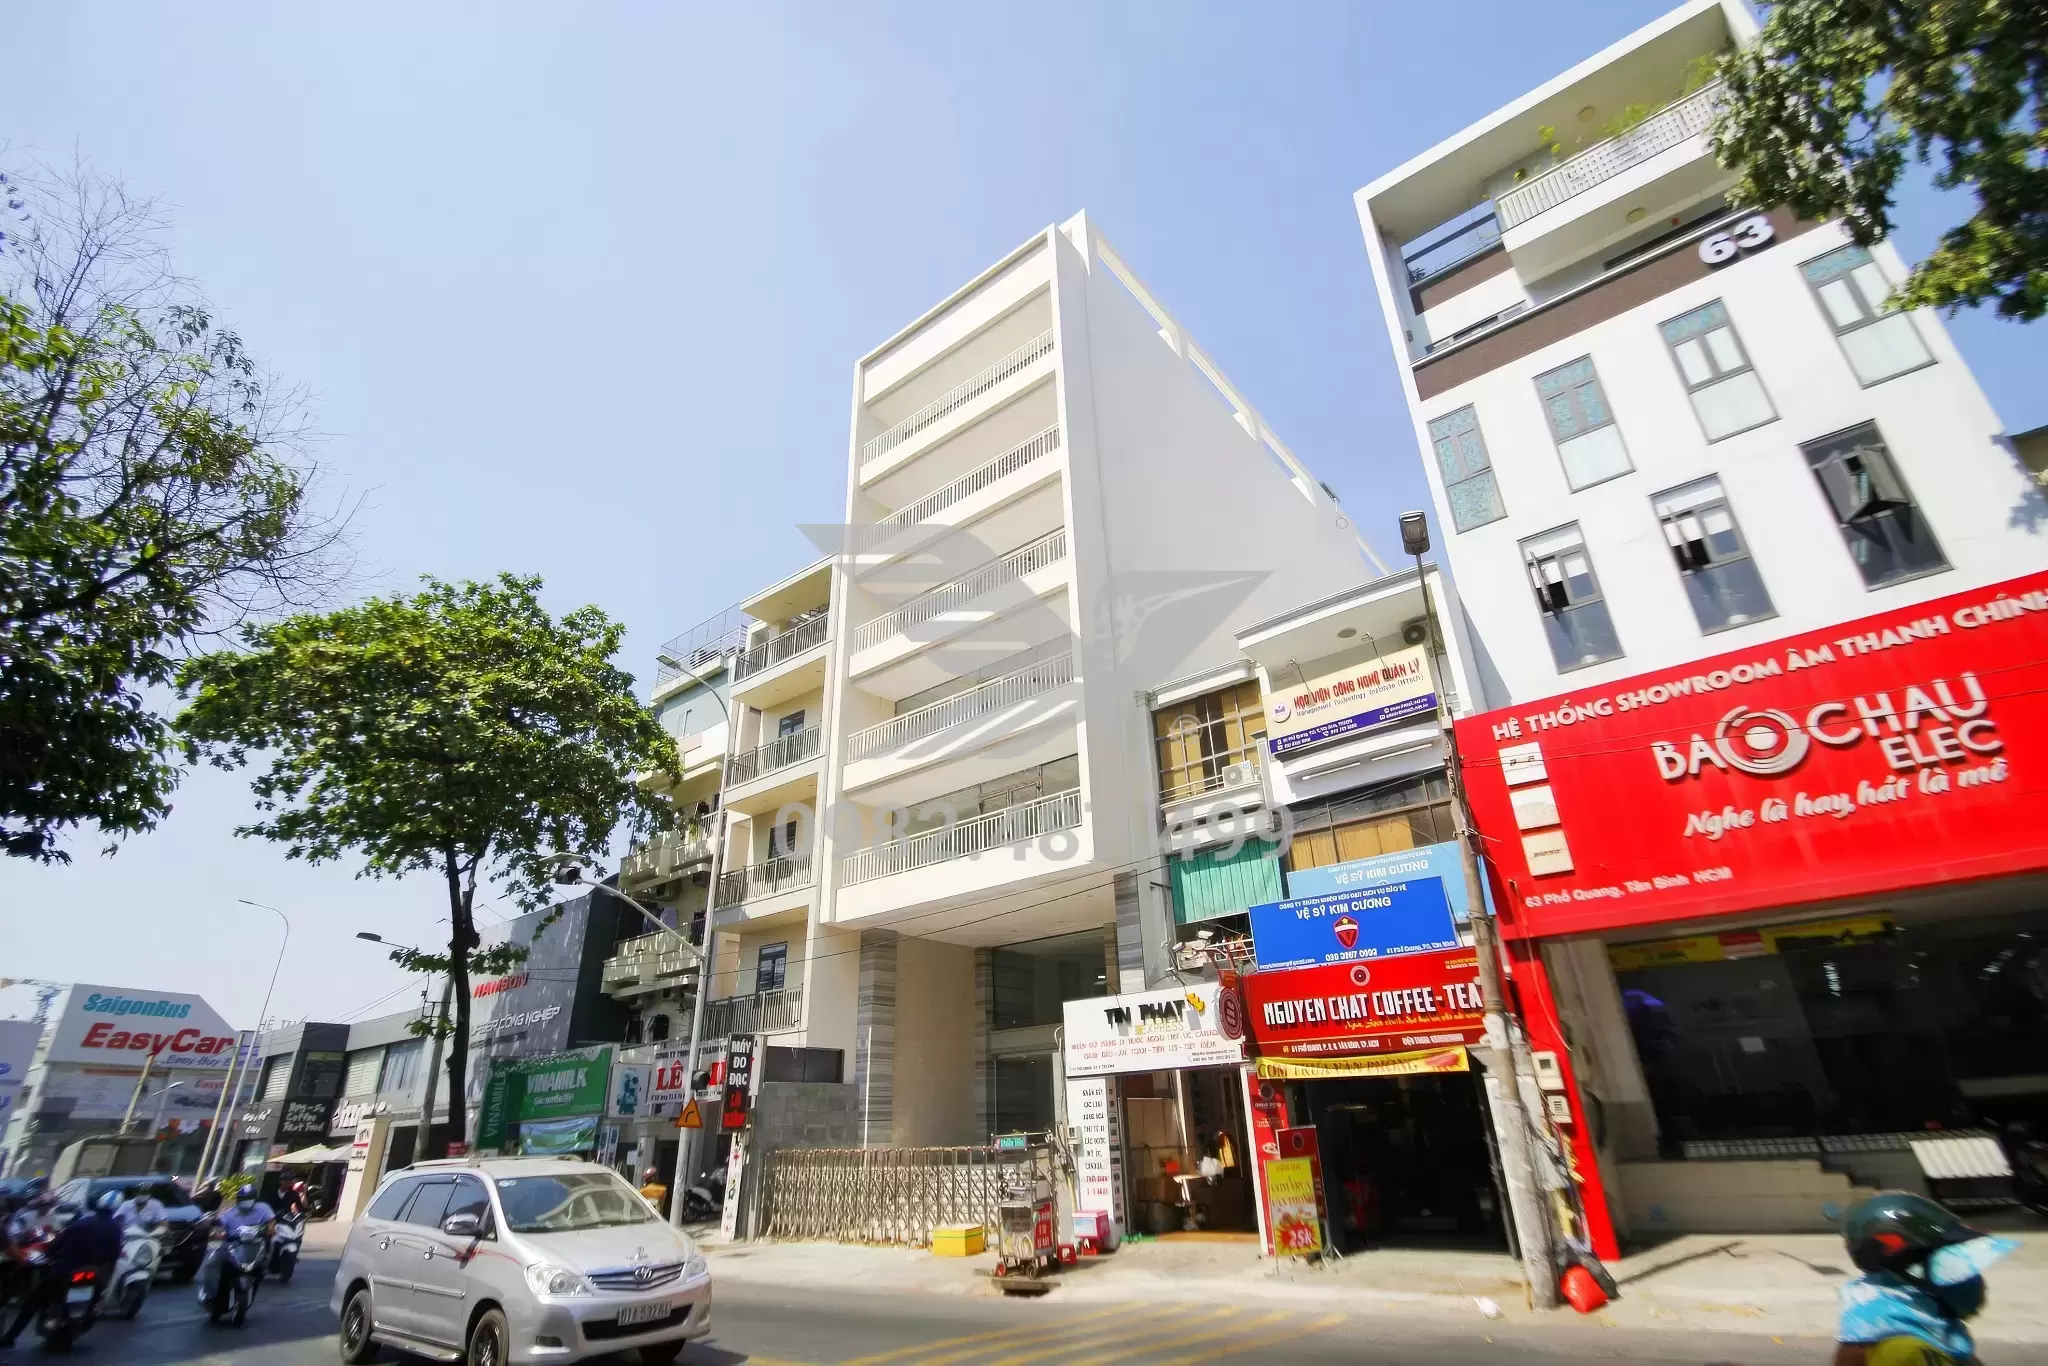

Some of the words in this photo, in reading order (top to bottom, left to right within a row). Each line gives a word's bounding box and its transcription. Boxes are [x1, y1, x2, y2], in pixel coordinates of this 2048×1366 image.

[1699, 215, 1774, 264] 63
[1491, 718, 1521, 742] HỆ
[1530, 698, 1614, 734] THỐNG
[1616, 657, 1784, 713] SHOWROOM
[1785, 645, 1836, 673] ÂM
[1836, 615, 1950, 656] THANH
[1879, 719, 2004, 769] ELEC
[1683, 805, 1755, 840] Nghe
[1760, 797, 1789, 824] là
[1794, 791, 1857, 819] hay,
[1857, 774, 1912, 807] hát
[1918, 766, 1950, 794] là
[1958, 756, 2010, 788] mê
[1335, 872, 1349, 885] VỆ
[1366, 867, 1387, 880] KIM
[1296, 907, 1310, 920] VỆ
[1330, 902, 1349, 914] KIM
[1525, 896, 1542, 908] 63
[83, 993, 191, 1018] SaigonBus
[1263, 997, 1327, 1025] NGUYEN
[1328, 993, 1369, 1020] CHAT
[80, 1022, 235, 1058] EasyCar
[656, 1060, 684, 1091] LÊ
[733, 1056, 747, 1069] ĐO
[527, 1068, 588, 1093] VINAMILK
